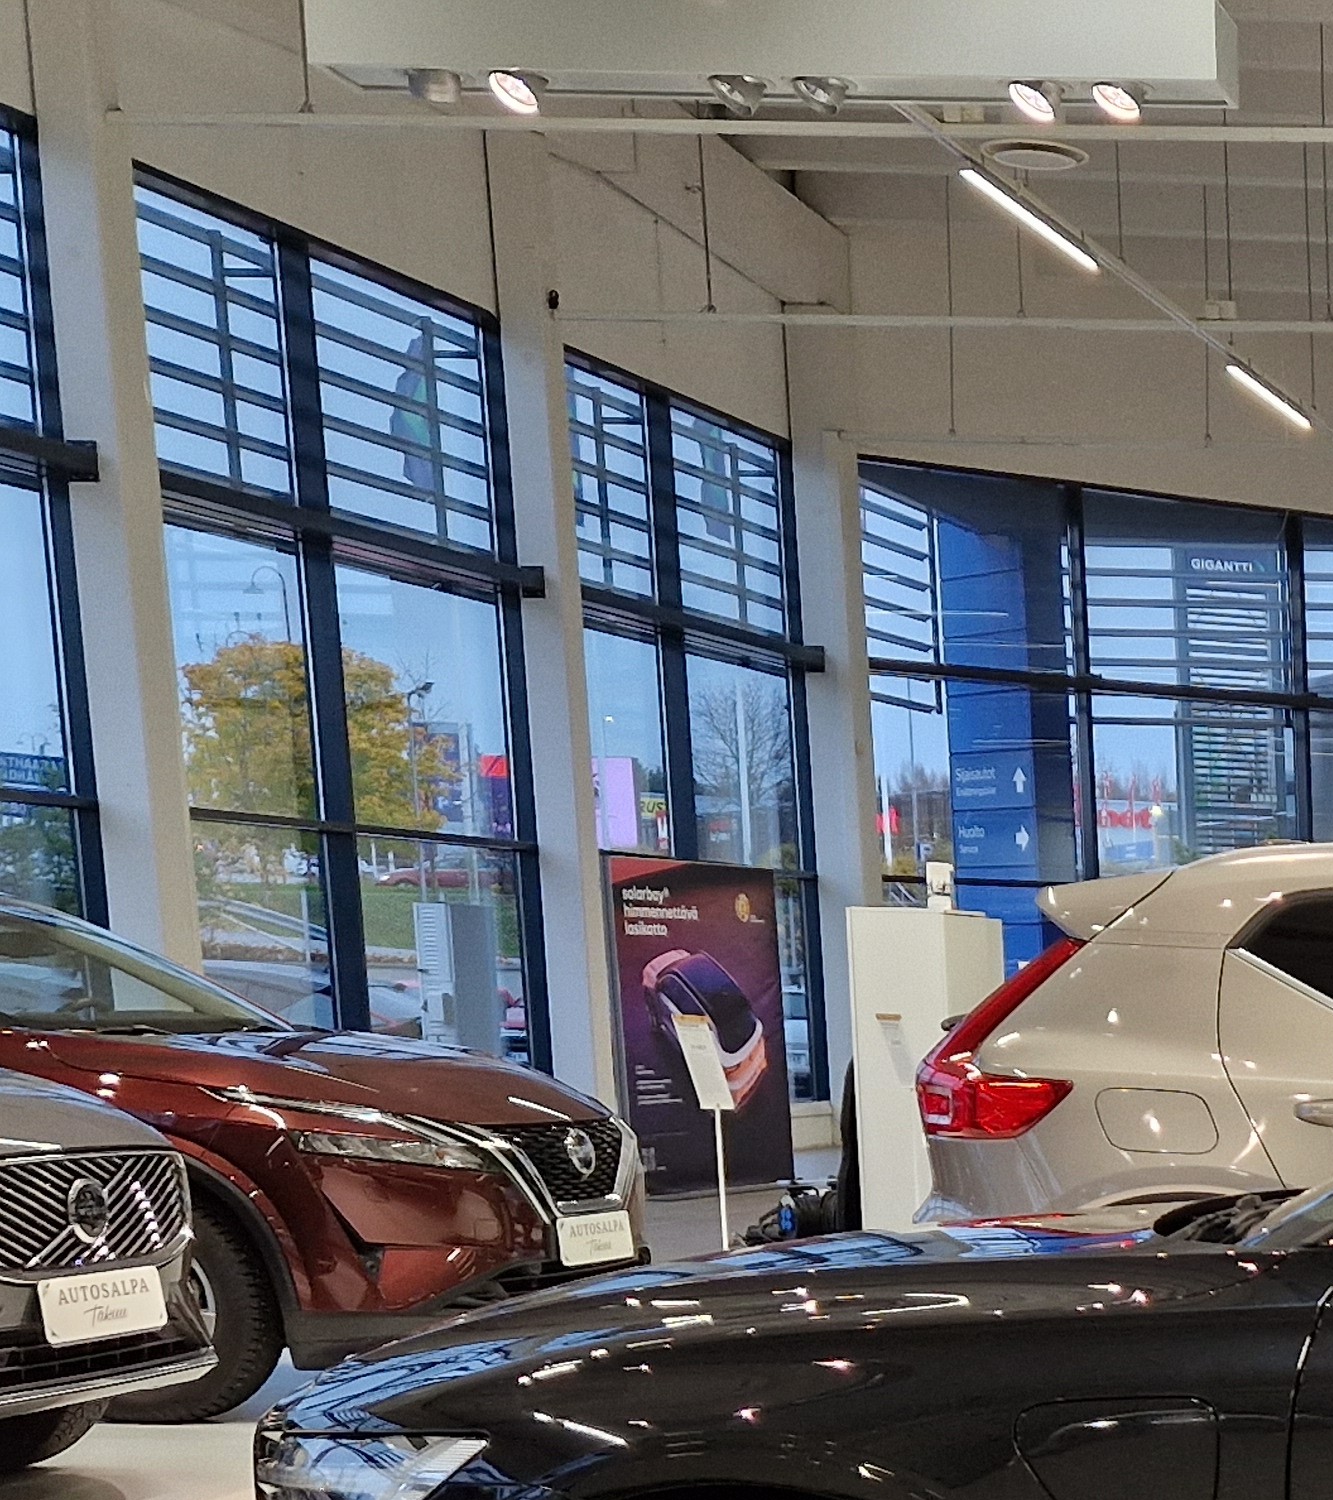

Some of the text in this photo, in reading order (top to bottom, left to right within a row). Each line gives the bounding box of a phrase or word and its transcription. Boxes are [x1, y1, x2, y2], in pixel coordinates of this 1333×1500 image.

[1190, 558, 1254, 573] GIGANTTI
[639, 800, 668, 814] RUS
[569, 1218, 625, 1239] AUTOSALPA
[58, 1277, 150, 1306] AUTOSALPA
